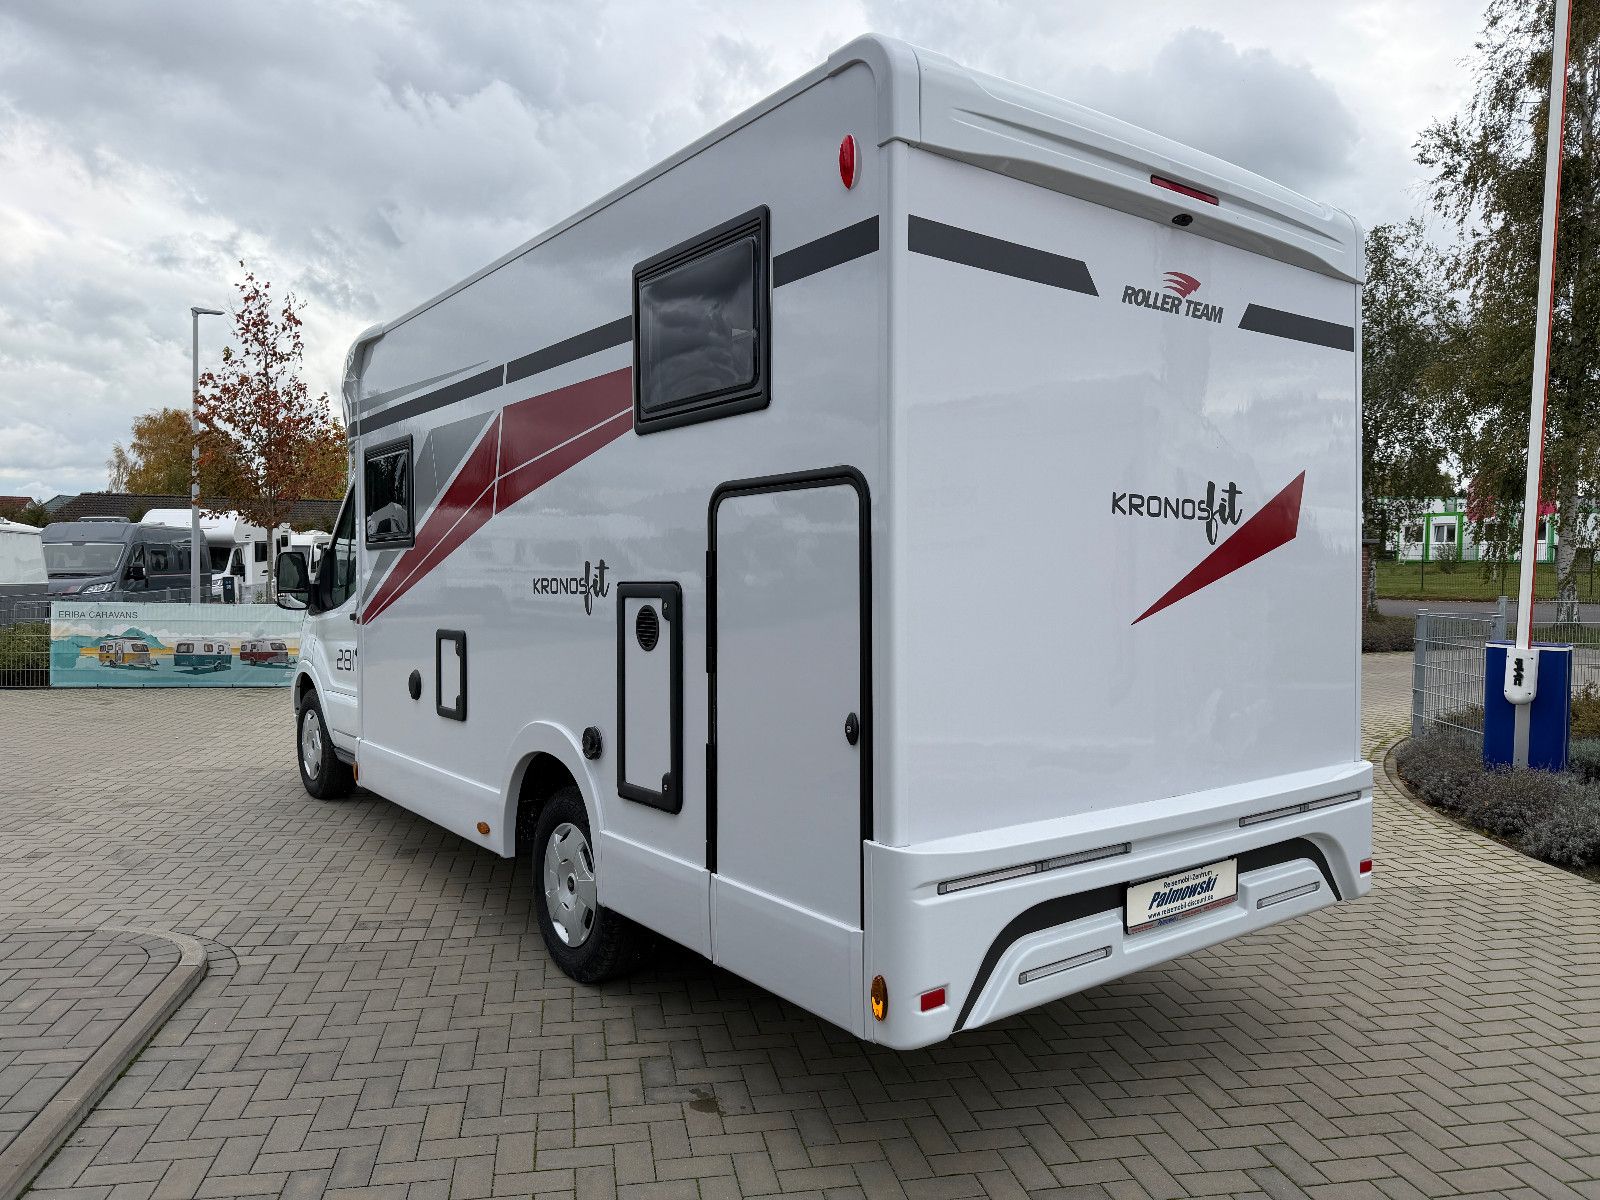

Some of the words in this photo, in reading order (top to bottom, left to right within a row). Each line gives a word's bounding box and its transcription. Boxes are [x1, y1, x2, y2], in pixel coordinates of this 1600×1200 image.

[1121, 284, 1183, 315] ROLLER
[1184, 298, 1224, 324] TEAM
[58, 610, 86, 619] ERIBA
[88, 610, 139, 620] CARAVANS
[1147, 874, 1219, 911] Palmowski
